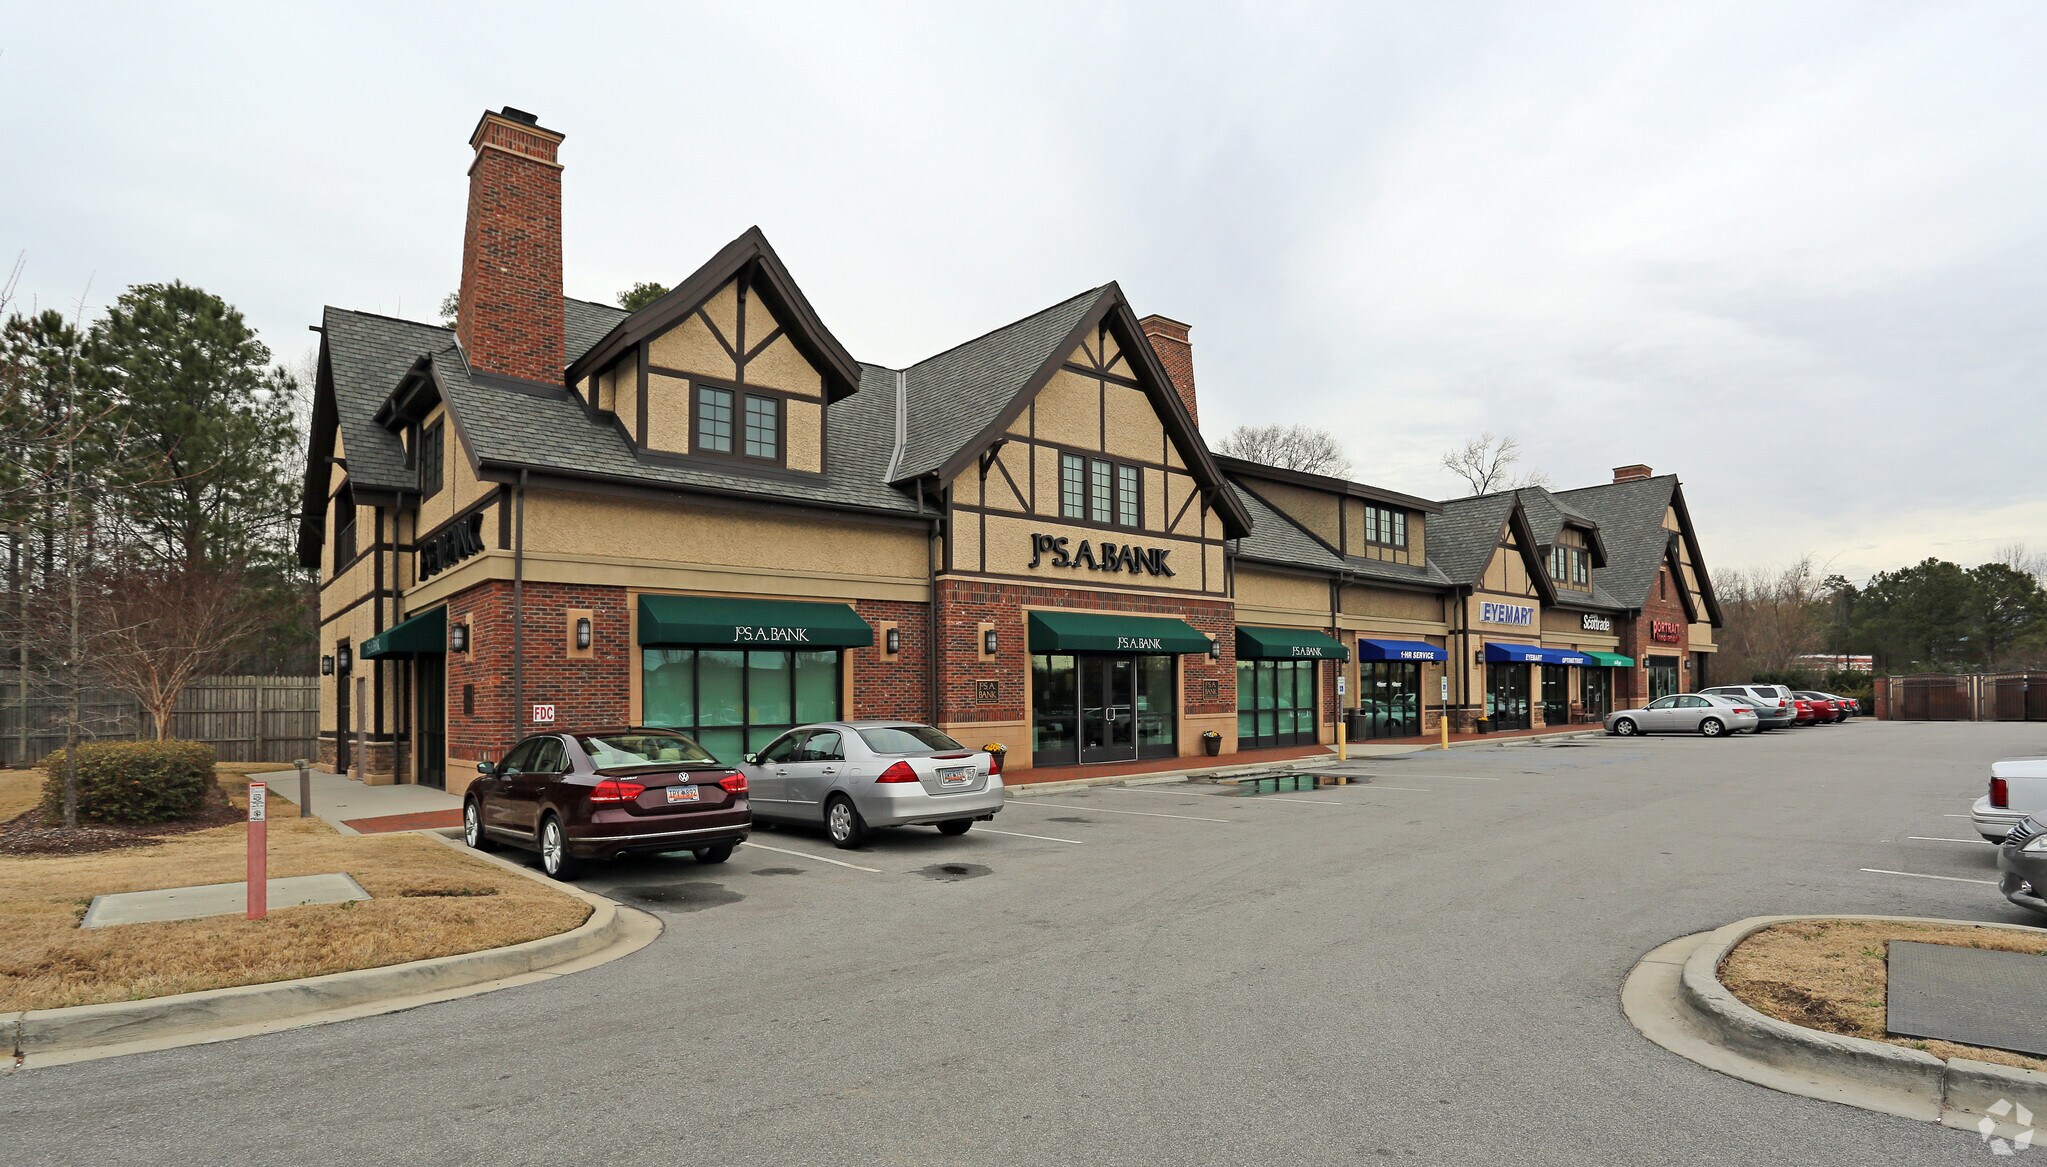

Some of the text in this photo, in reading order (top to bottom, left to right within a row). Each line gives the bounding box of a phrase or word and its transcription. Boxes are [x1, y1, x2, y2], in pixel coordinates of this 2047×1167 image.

[1101, 542, 1176, 577] BANK
[1483, 602, 1534, 625] EYEMART
[1583, 614, 1610, 631] Scottrade
[770, 627, 810, 642] BANK
[1138, 638, 1162, 649] BANK
[1305, 646, 1322, 657] BANK
[1412, 651, 1434, 660] SERVICE
[978, 690, 997, 699] BANK
[534, 706, 553, 720] FDC
